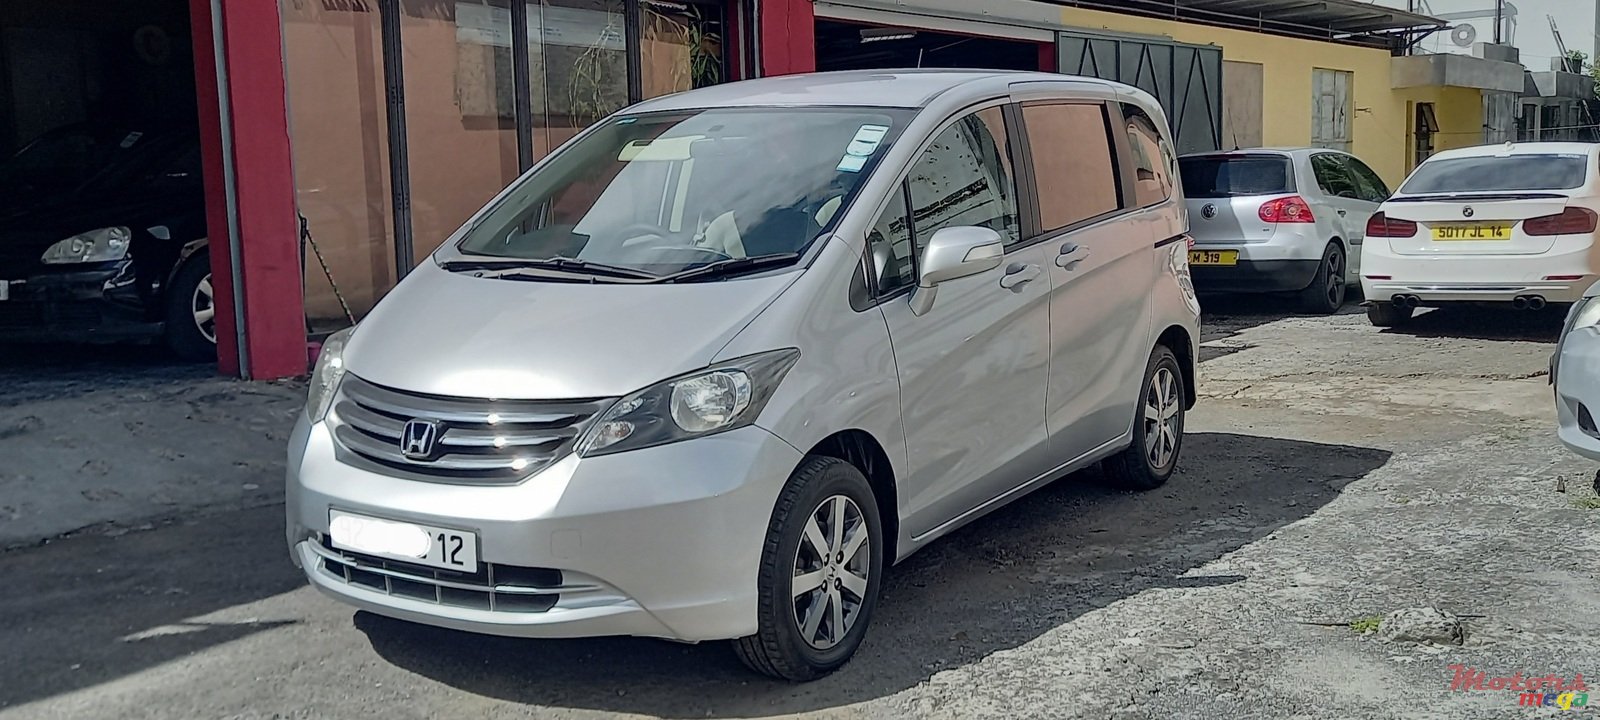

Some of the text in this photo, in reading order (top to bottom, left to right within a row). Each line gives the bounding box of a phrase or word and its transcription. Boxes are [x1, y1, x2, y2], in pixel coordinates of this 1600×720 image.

[1438, 224, 1503, 238] 5017 JL 14
[1203, 252, 1220, 263] 319
[437, 533, 465, 566] 12
